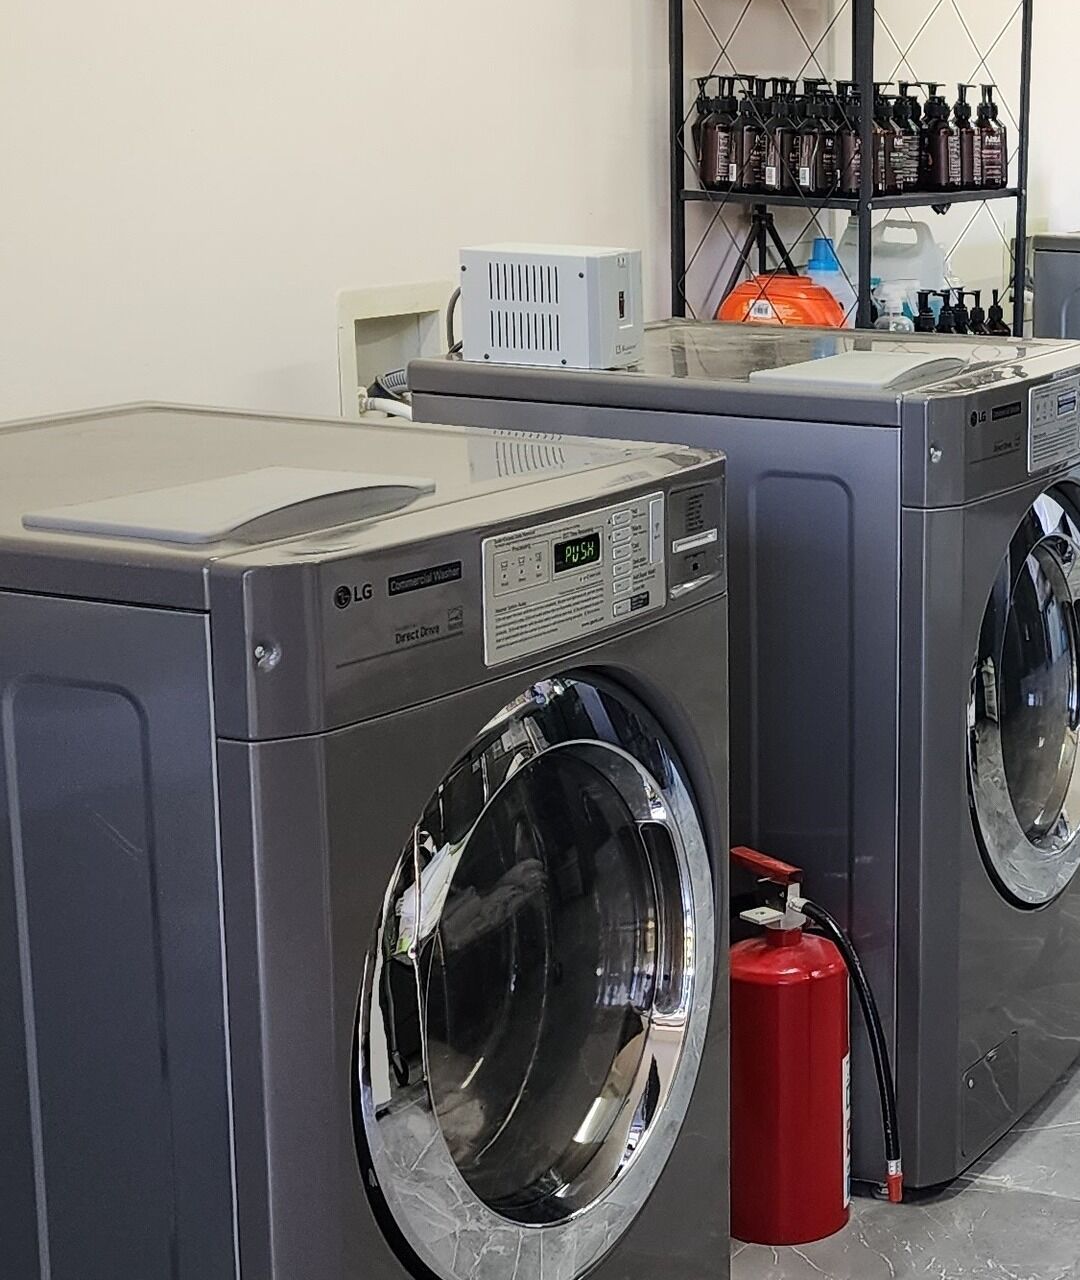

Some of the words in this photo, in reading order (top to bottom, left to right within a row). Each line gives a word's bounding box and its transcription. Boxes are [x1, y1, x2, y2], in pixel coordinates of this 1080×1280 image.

[978, 411, 987, 423] LG
[565, 541, 595, 563] PUSH
[391, 571, 432, 592] Commercial
[432, 567, 460, 582] Washer
[353, 583, 373, 602] LG
[395, 629, 420, 644] Direct
[420, 624, 440, 638] Drive
